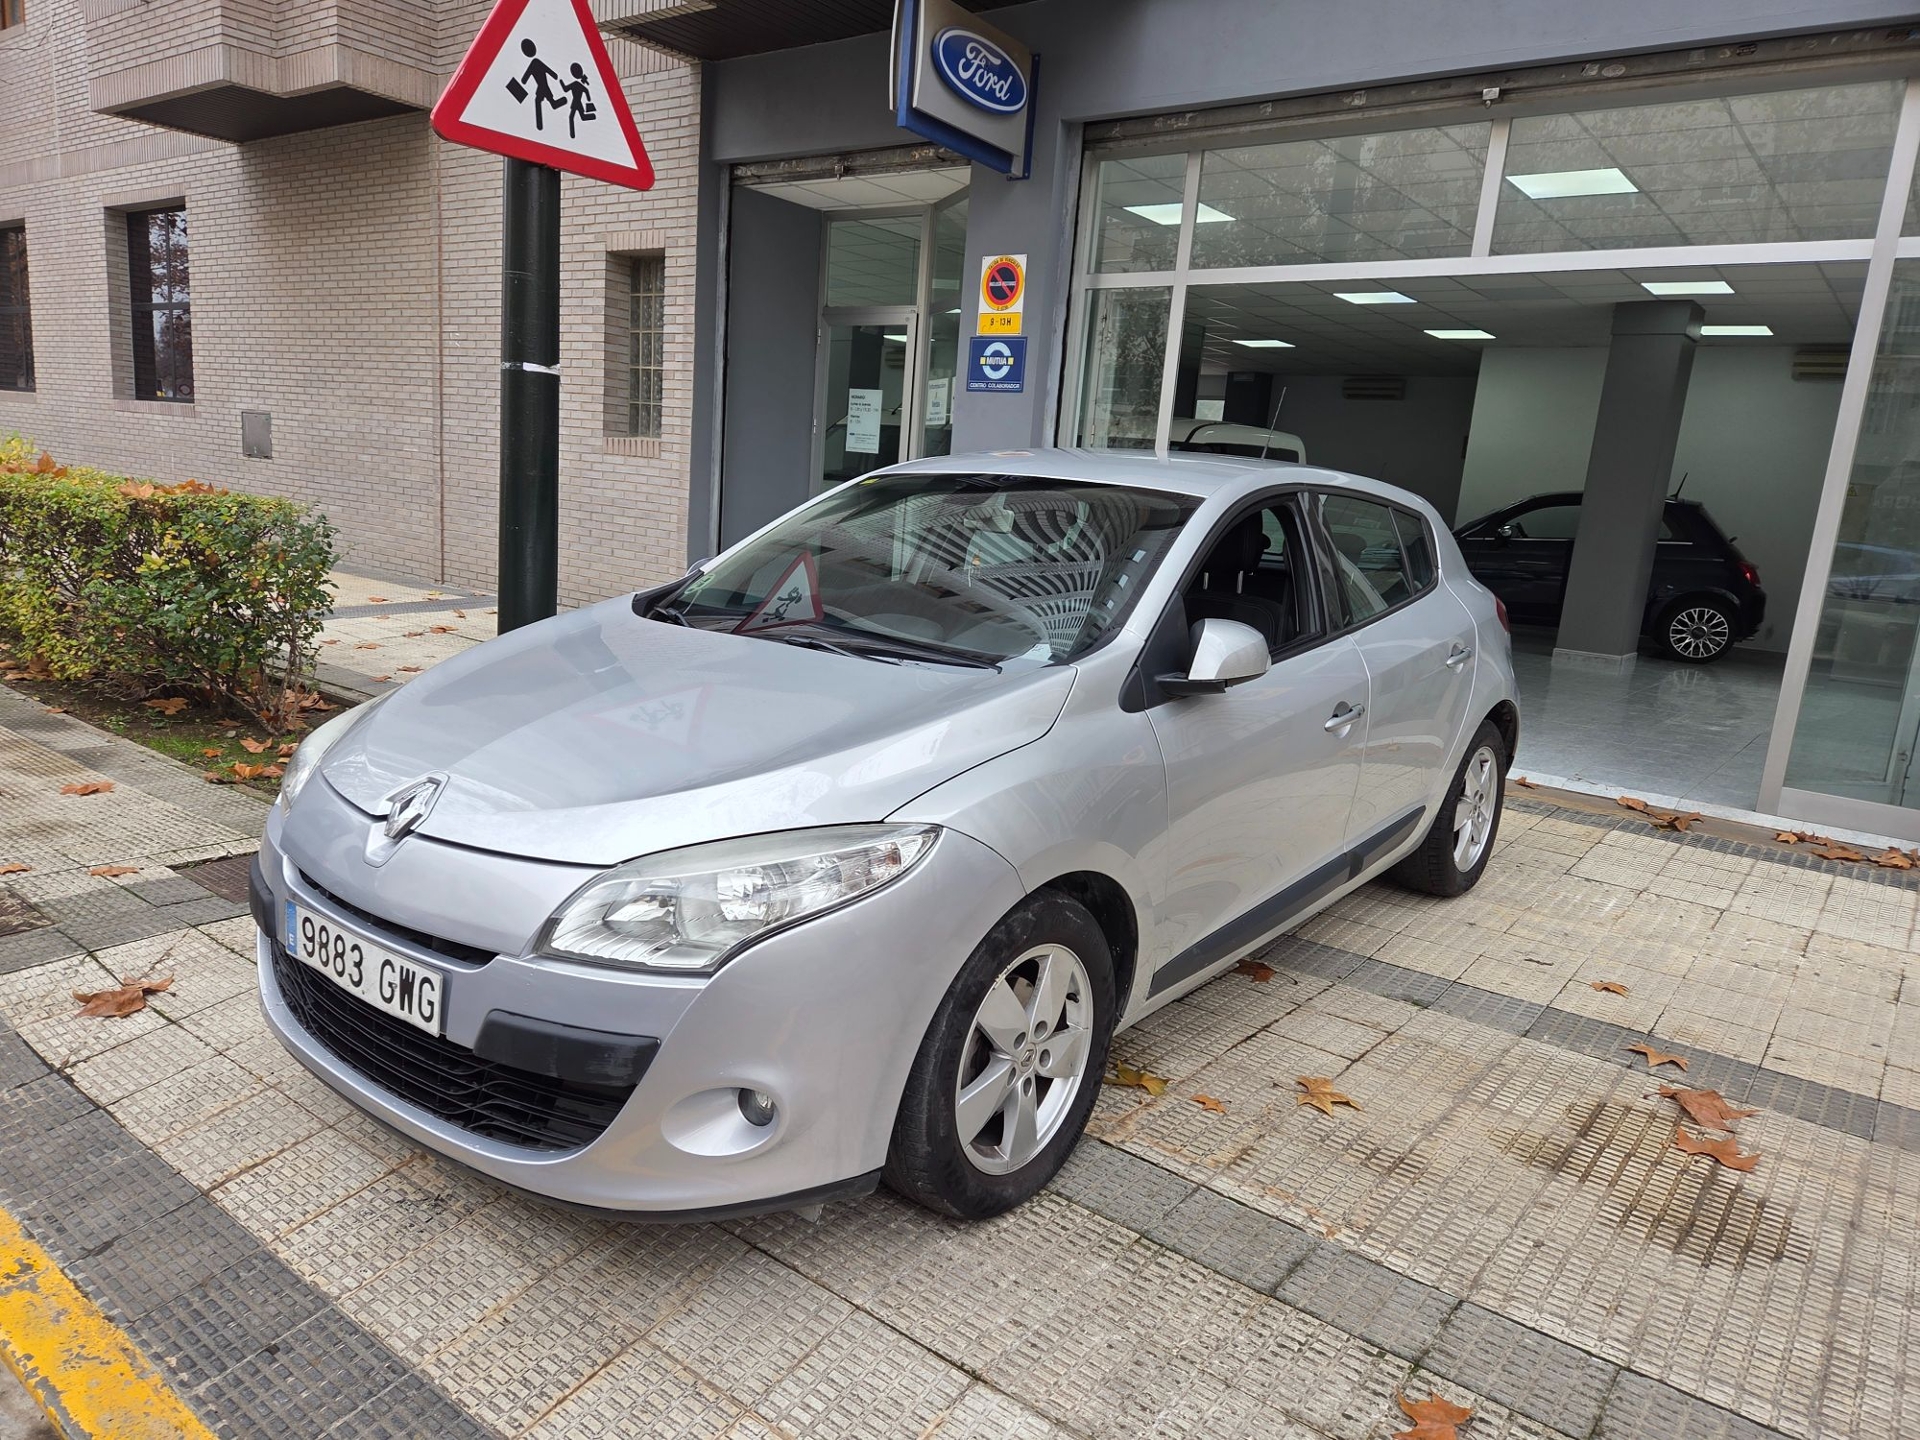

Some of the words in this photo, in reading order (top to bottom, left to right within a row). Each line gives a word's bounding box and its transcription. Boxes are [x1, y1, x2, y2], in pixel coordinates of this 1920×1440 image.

[958, 42, 1013, 100] Ford
[986, 356, 1007, 365] MUTUA
[302, 916, 364, 988] 9883
[379, 959, 436, 1023] GWG
